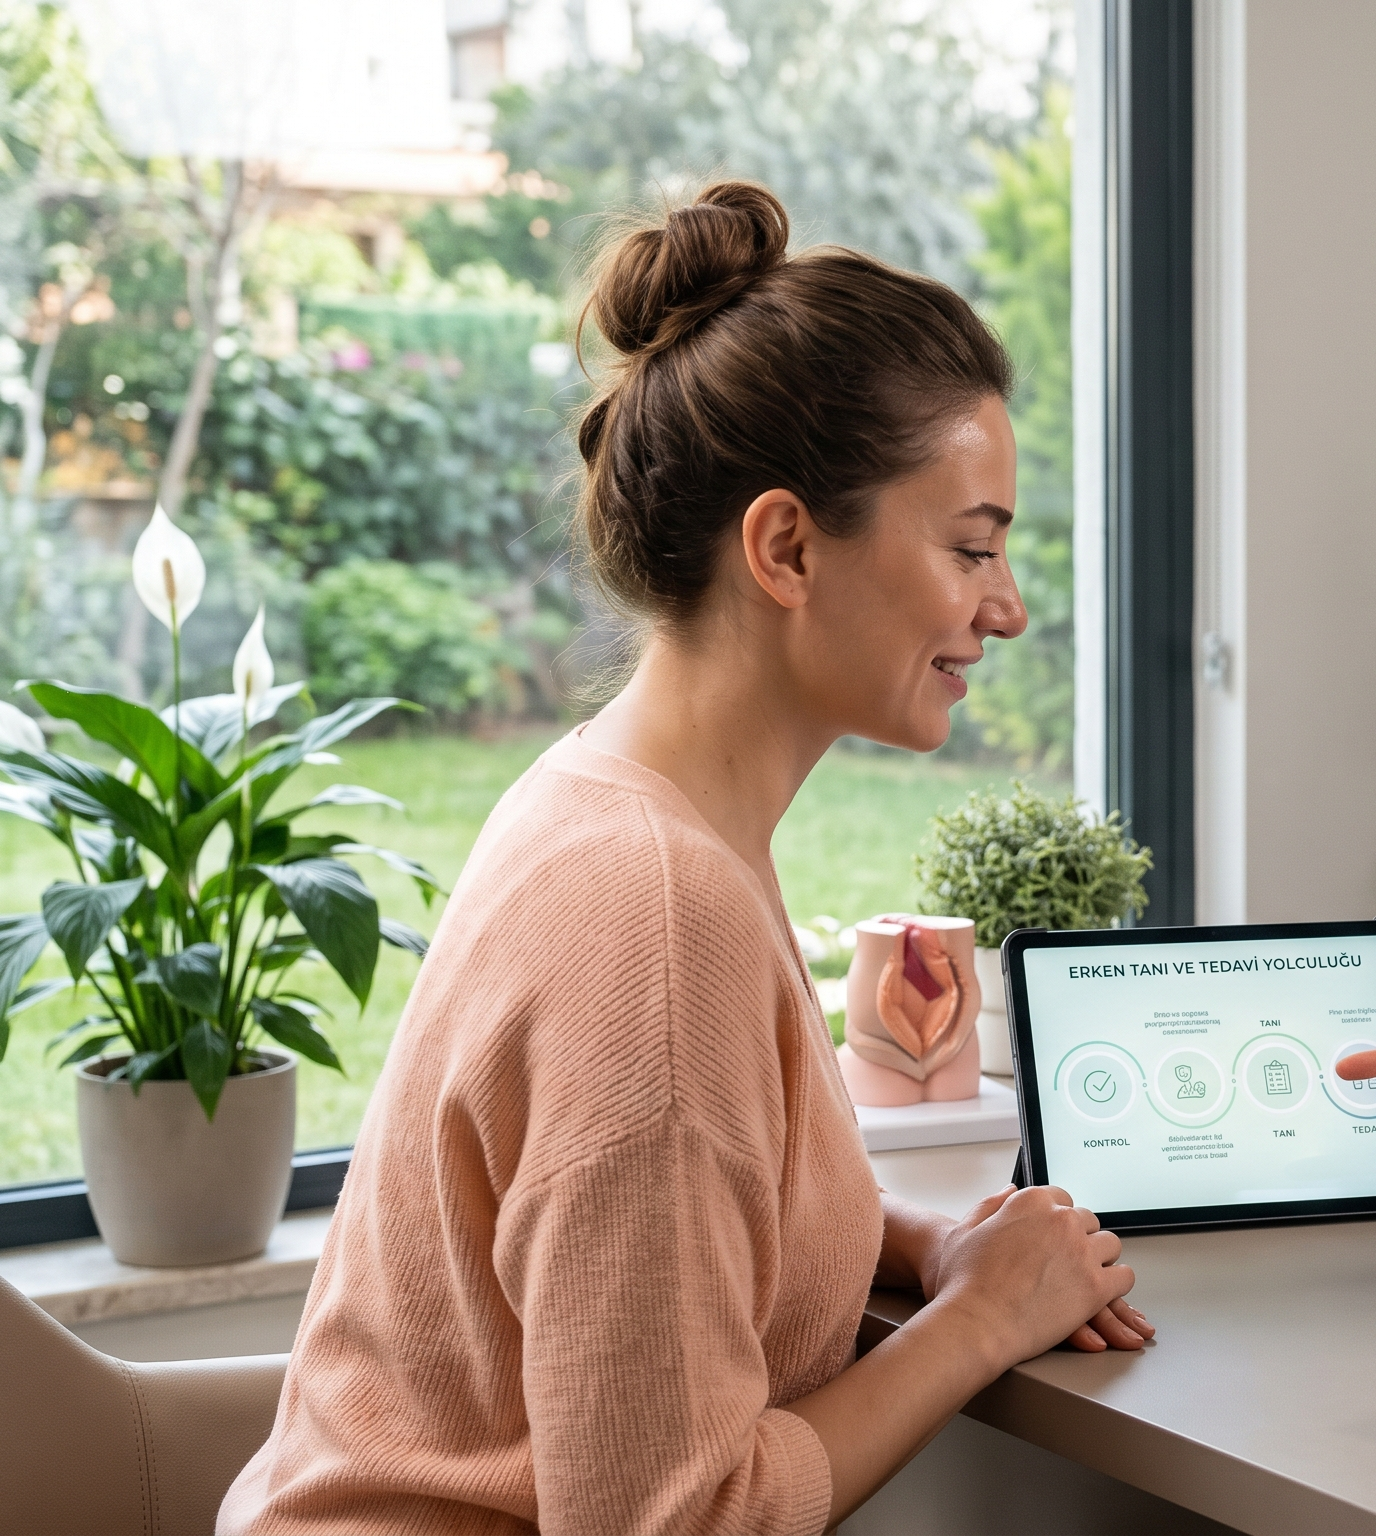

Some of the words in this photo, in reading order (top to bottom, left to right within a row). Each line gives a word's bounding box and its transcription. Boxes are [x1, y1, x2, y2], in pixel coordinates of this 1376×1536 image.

[1069, 964, 1125, 979] ERKEN
[1130, 962, 1168, 976] TANI
[1172, 962, 1195, 975] VE
[1199, 955, 1259, 973] TEDAVİ
[1262, 952, 1362, 971] YOLCULUĞU
[1260, 1019, 1281, 1027] TANI
[1273, 1129, 1295, 1138] TANI
[1083, 1138, 1131, 1148] KONTROL
